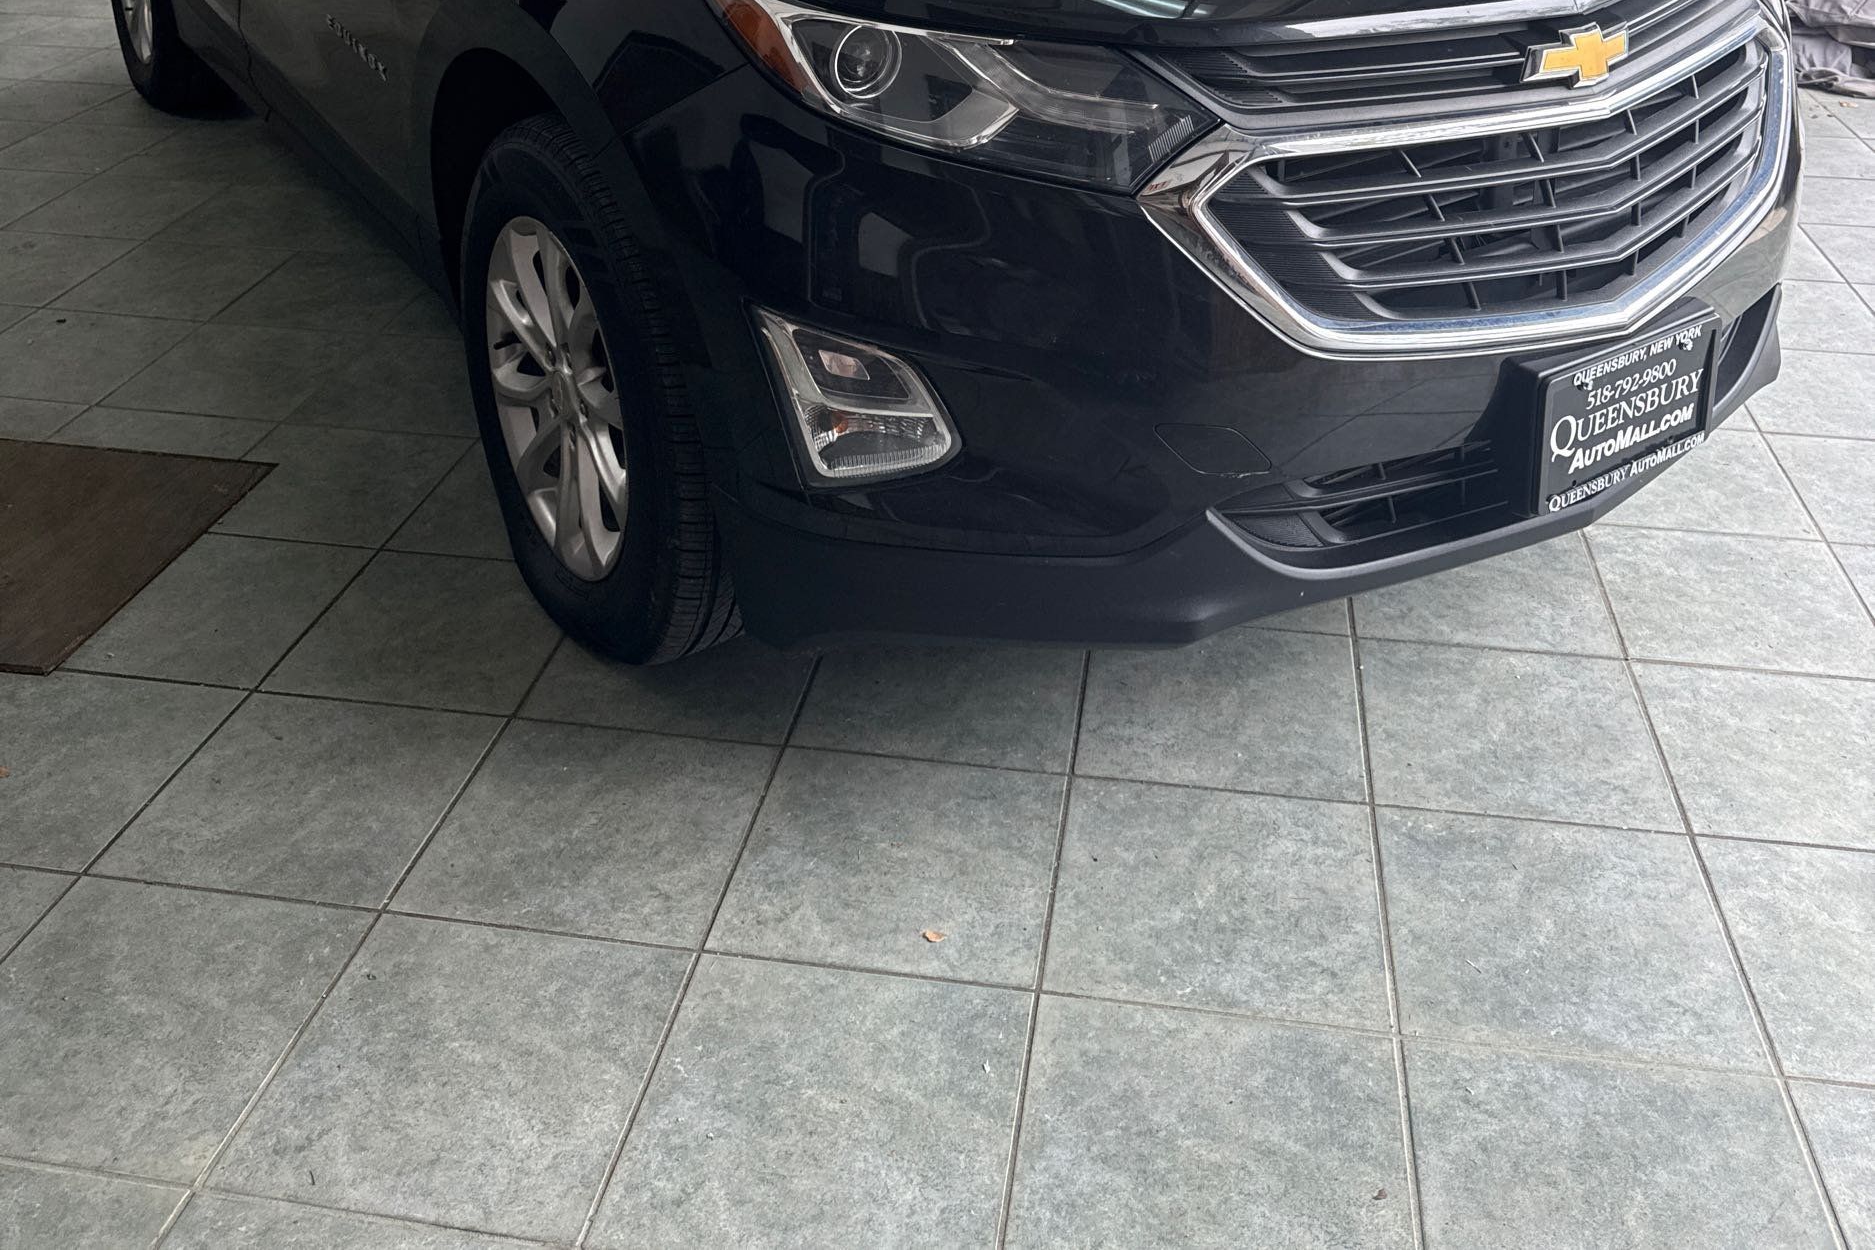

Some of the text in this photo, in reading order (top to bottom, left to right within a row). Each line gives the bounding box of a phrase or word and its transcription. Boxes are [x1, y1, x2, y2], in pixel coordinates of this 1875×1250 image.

[1573, 325, 1702, 386] QUEENSBURY, NEW YORK
[1586, 358, 1677, 410] 518-792-9800
[1550, 368, 1703, 462] QUEENSBURY
[1548, 465, 1629, 512] QUEENSBURY
